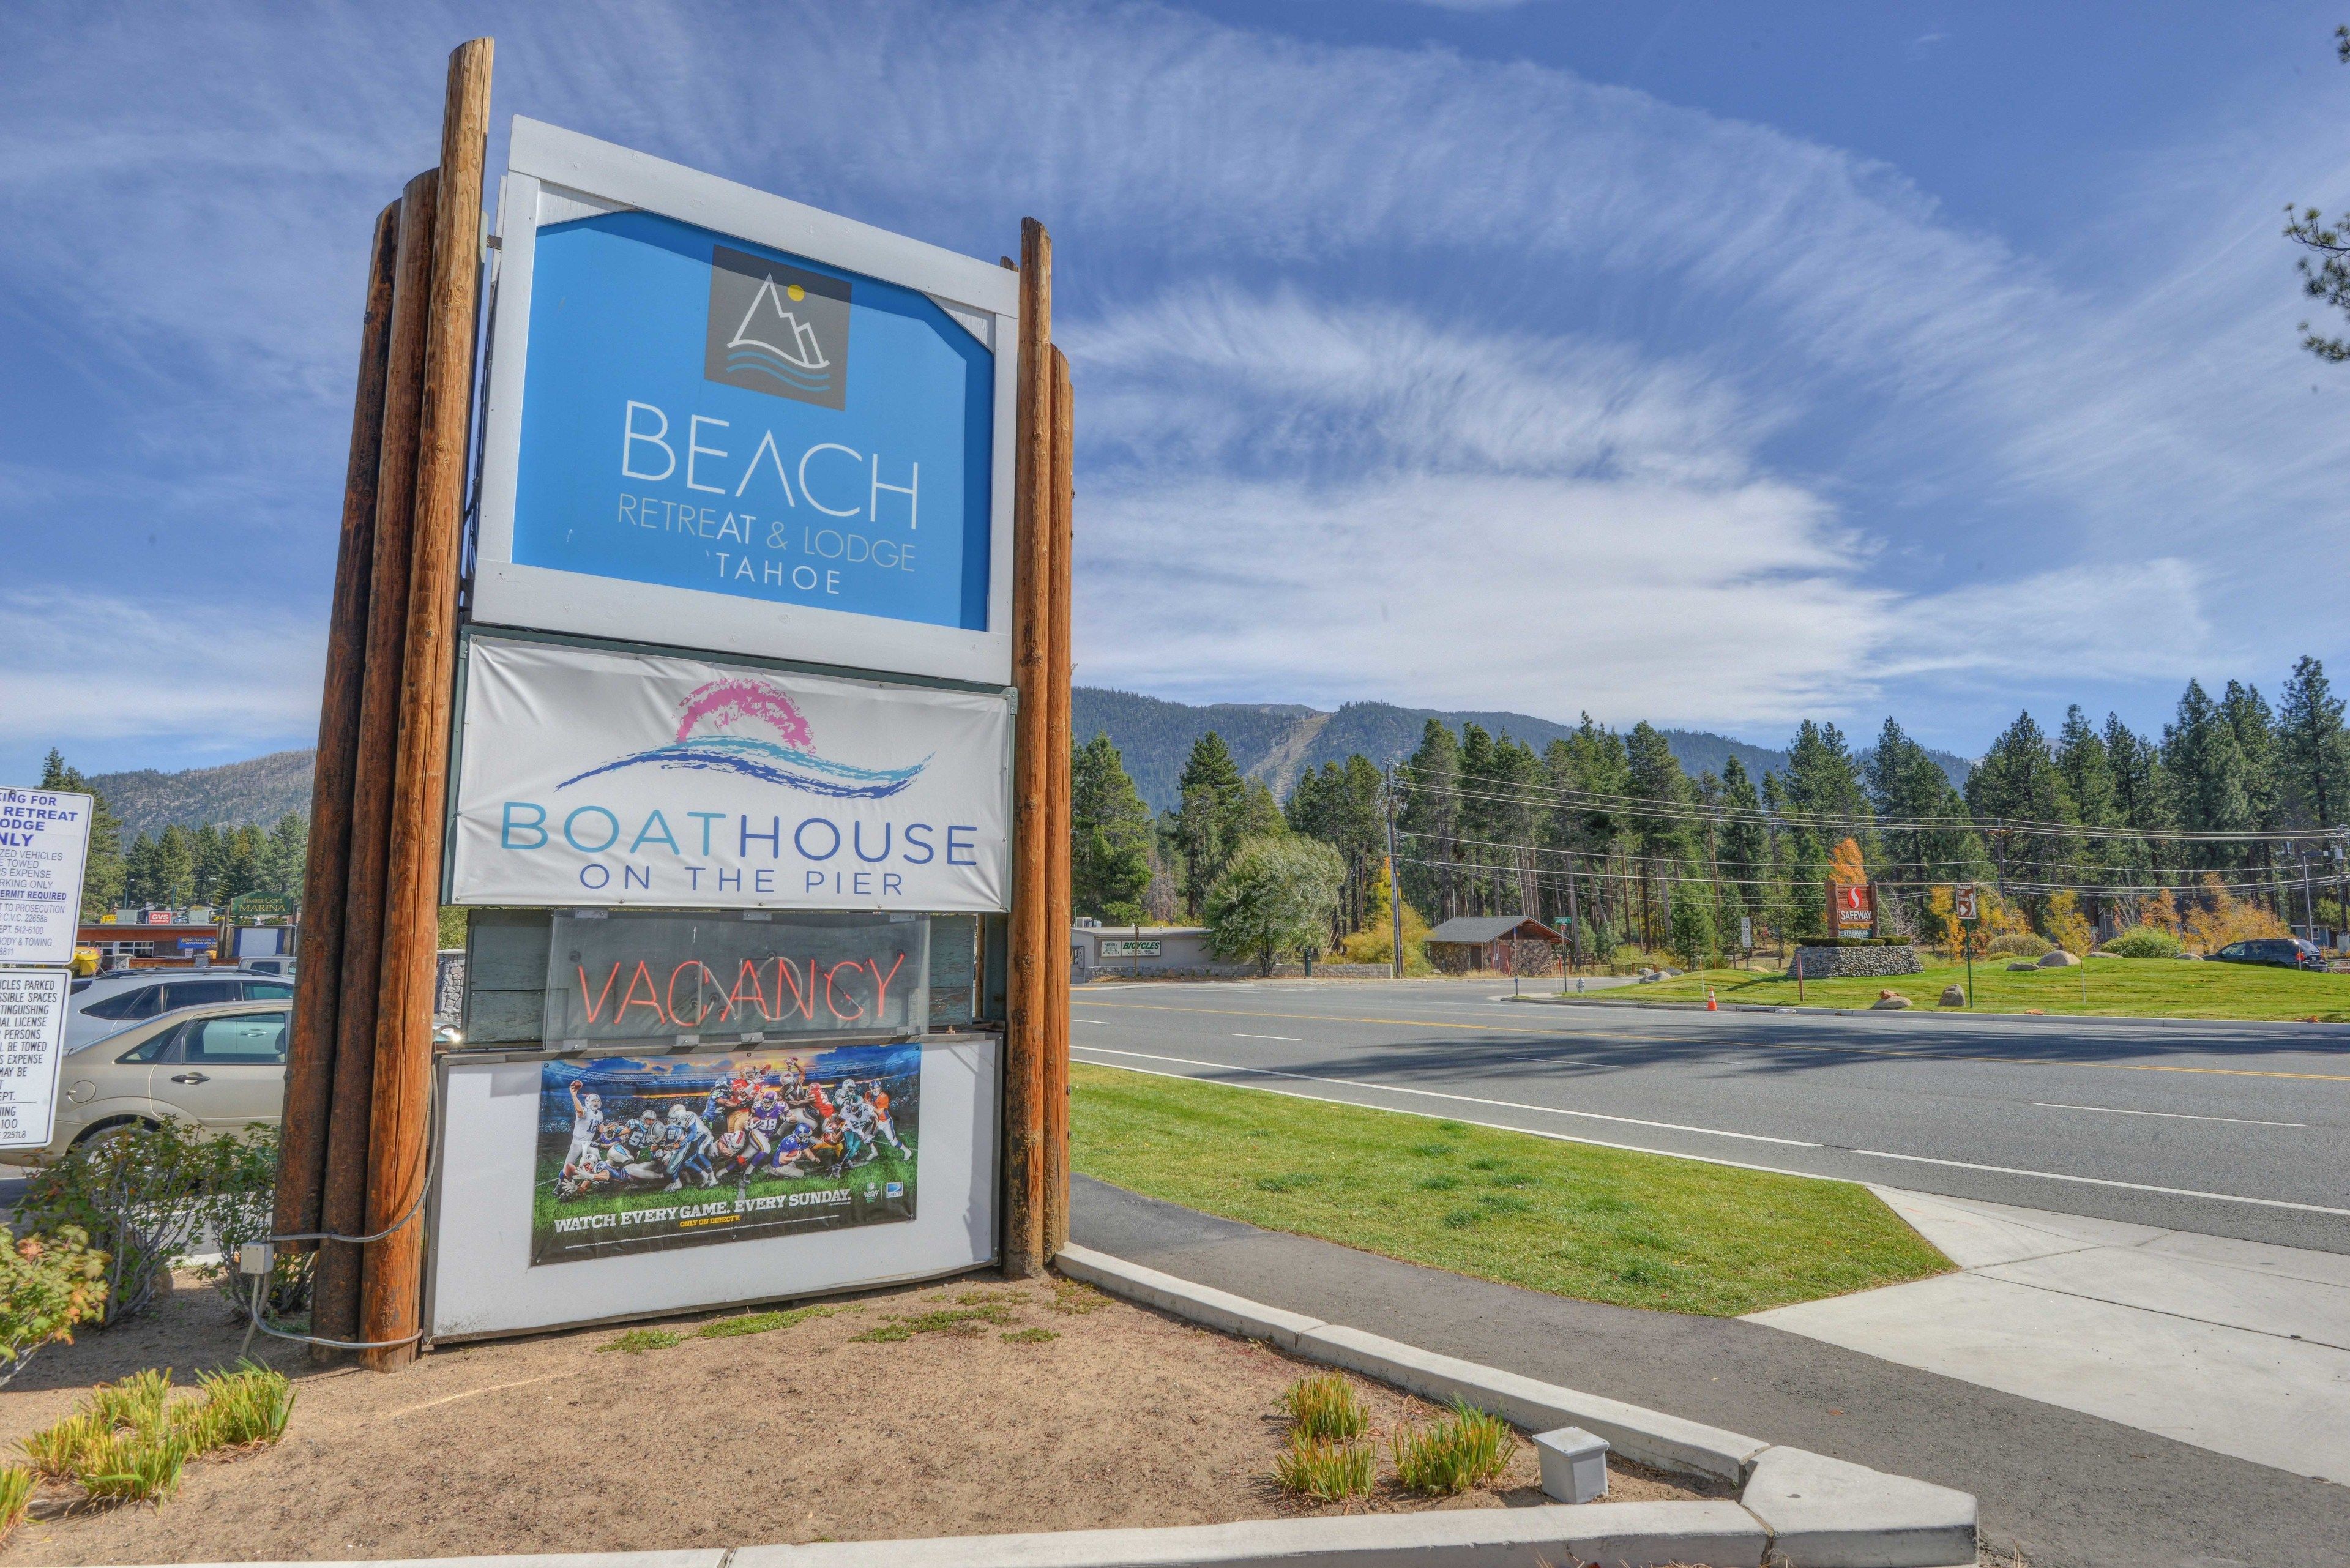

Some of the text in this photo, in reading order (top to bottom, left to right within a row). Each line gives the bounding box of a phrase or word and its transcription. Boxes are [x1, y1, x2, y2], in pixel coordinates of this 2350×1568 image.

[621, 399, 919, 530] BEACH
[618, 493, 916, 572] RETREAT & LODGE
[716, 552, 841, 595] TAHOE
[0, 793, 56, 806] ING FOR
[4, 806, 78, 821] RETREAT
[501, 801, 977, 865] BOATHOUSE
[20, 850, 63, 861] VEHICLES
[7, 859, 39, 868] TOWED
[10, 868, 51, 878] EXPENSE
[29, 880, 53, 889] ONLY
[580, 864, 902, 895] ON THE PIER
[28, 891, 67, 900] REQUIRED
[15, 903, 65, 914] PROSECUTION
[24, 914, 48, 923] 22658a
[1841, 910, 1871, 920] SAFEWAY
[14, 925, 43, 935] 542-6100
[18, 937, 23, 946] &
[25, 938, 53, 947] TOWING
[1122, 941, 1160, 950] BICYCLES
[24, 980, 55, 990] PARKED
[578, 953, 904, 1026] VACANCY
[28, 992, 58, 1002] SPACES
[15, 1017, 47, 1027] LICENSE
[4, 1029, 41, 1039] PERSONS
[7, 1042, 18, 1051] BE
[21, 1042, 47, 1051] TOWED
[7, 1054, 43, 1064] EXPENSE
[17, 1067, 28, 1077] BE
[554, 1189, 851, 1233] WATCH EVERY GAME. EVERY SUNDAY.
